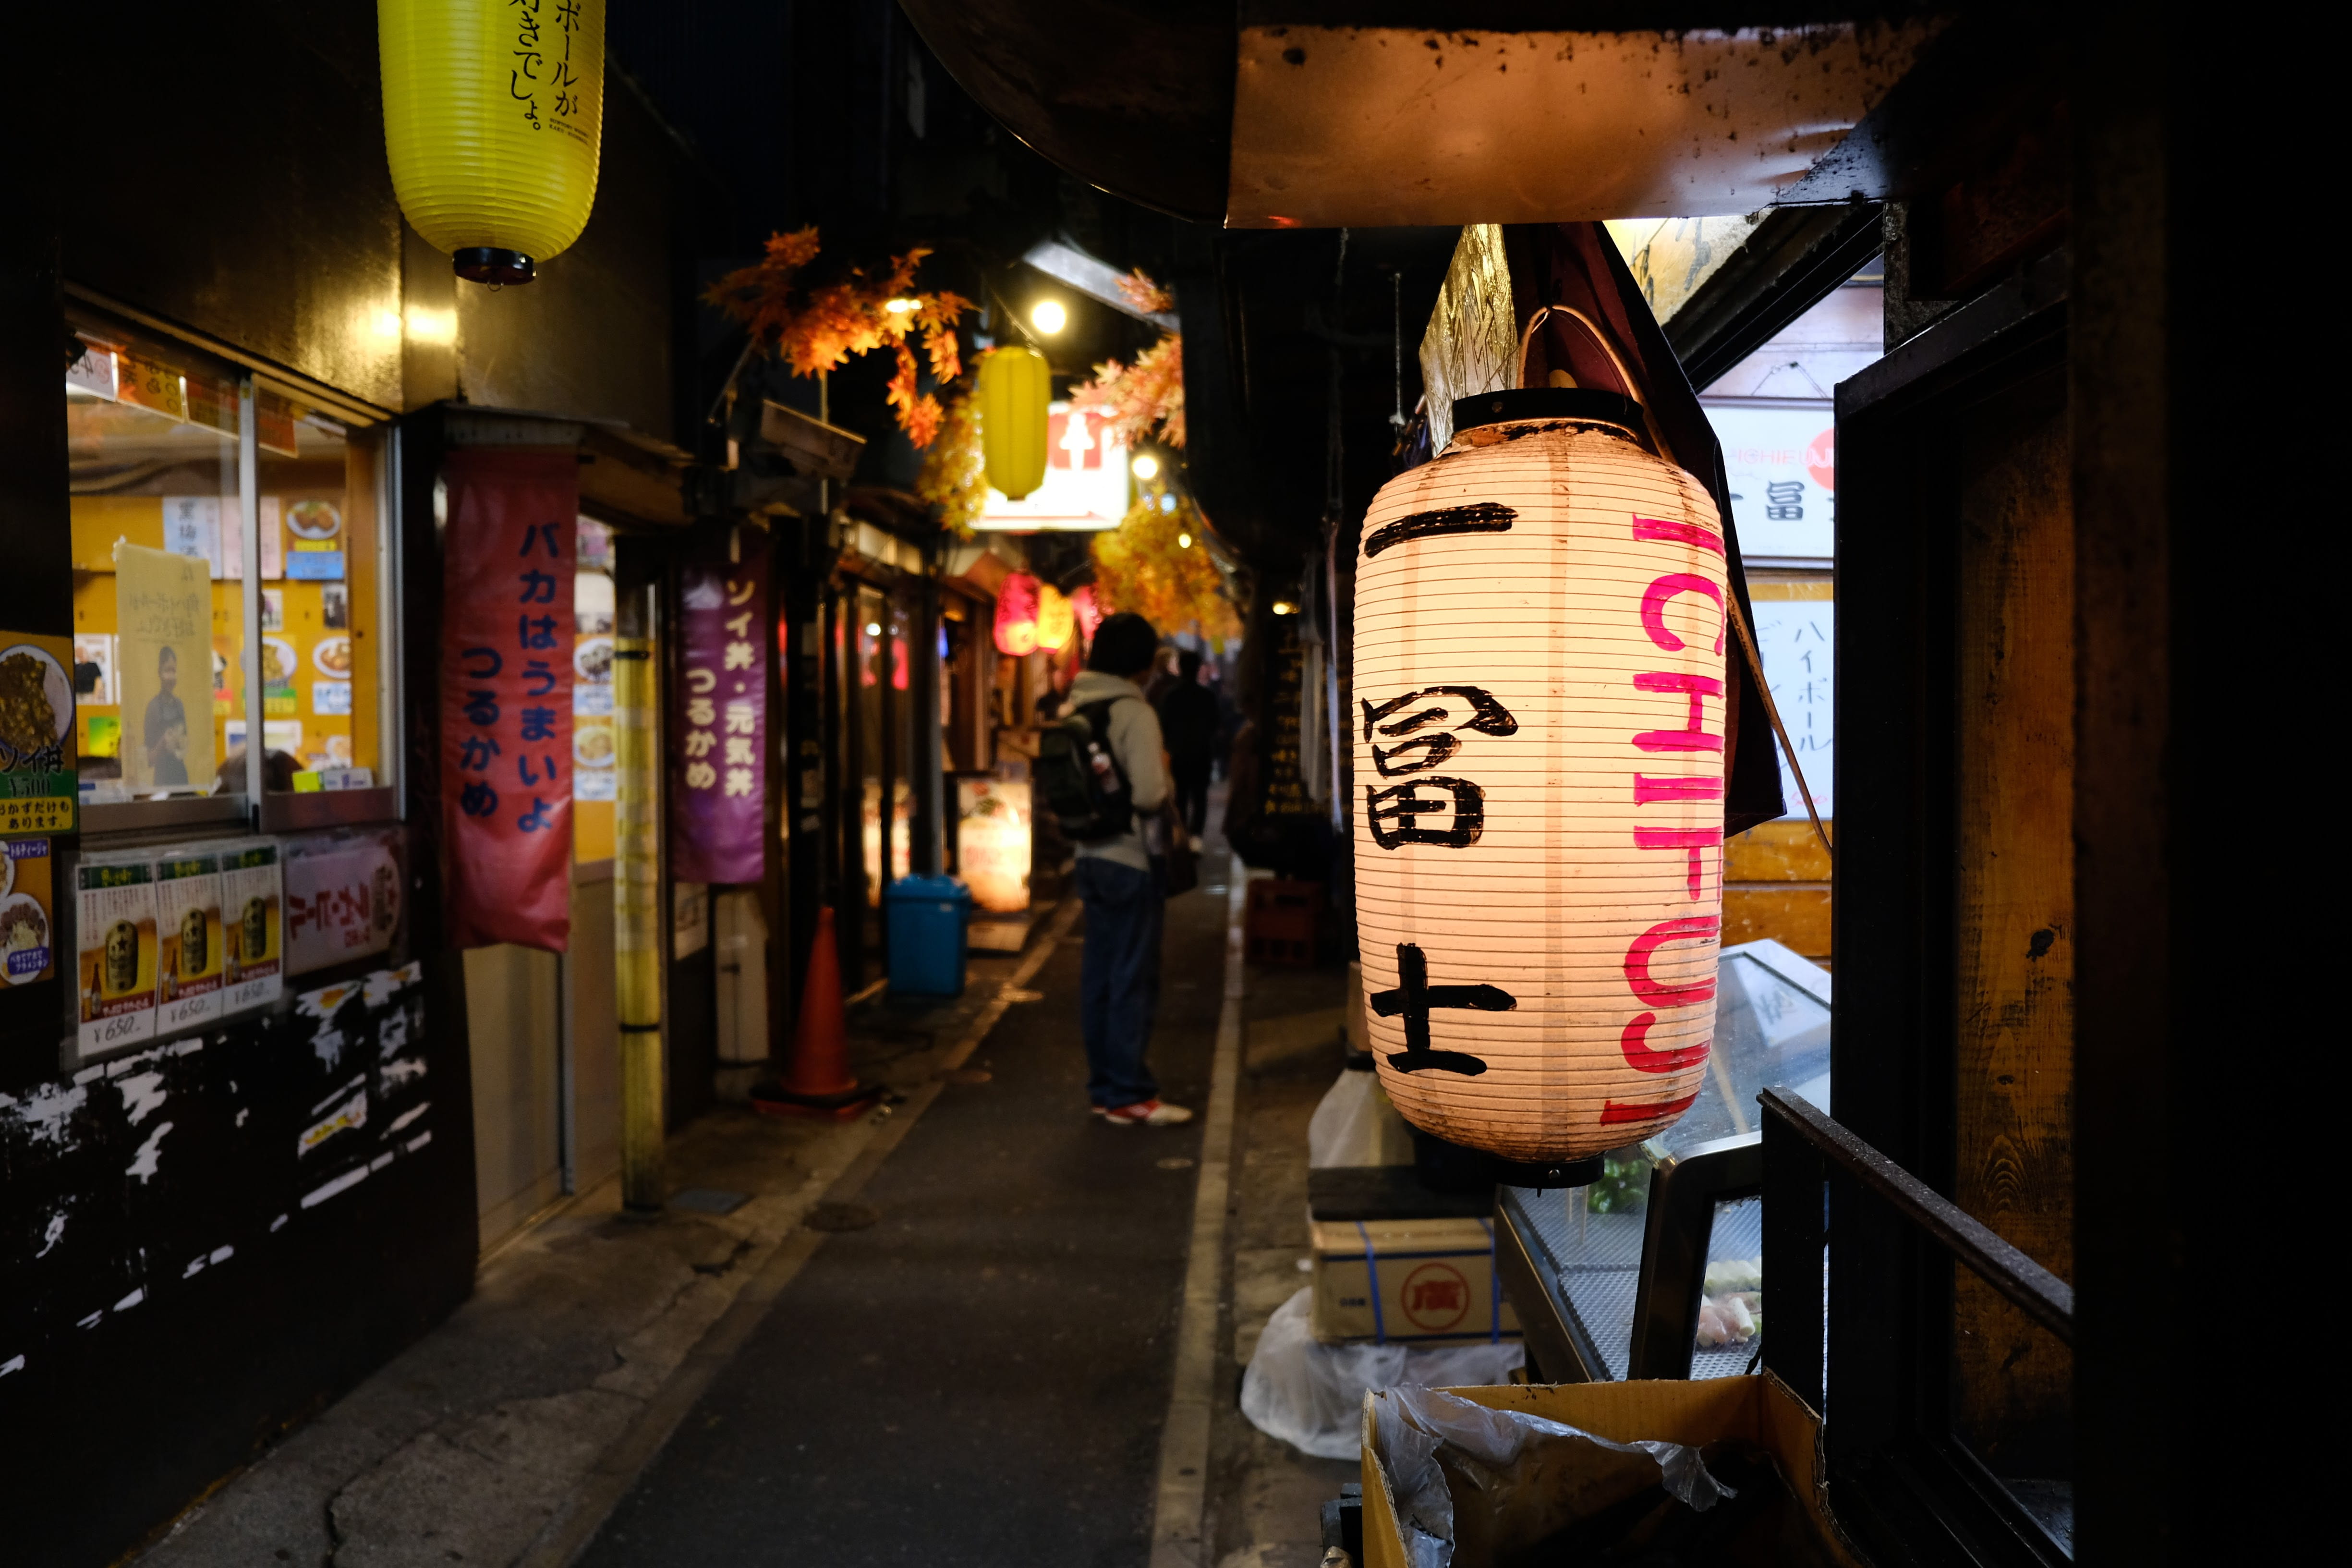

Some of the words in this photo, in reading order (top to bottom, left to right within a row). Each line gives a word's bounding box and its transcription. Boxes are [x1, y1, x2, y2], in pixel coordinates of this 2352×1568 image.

[461, 647, 502, 817] つるかめ
[518, 523, 560, 833] バカはうまいよ
[685, 668, 717, 790] つるかめ
[1794, 621, 1832, 752] ハイボール
[0, 746, 64, 774] ソイ丼
[1600, 513, 1726, 1127] ICHIFUJI
